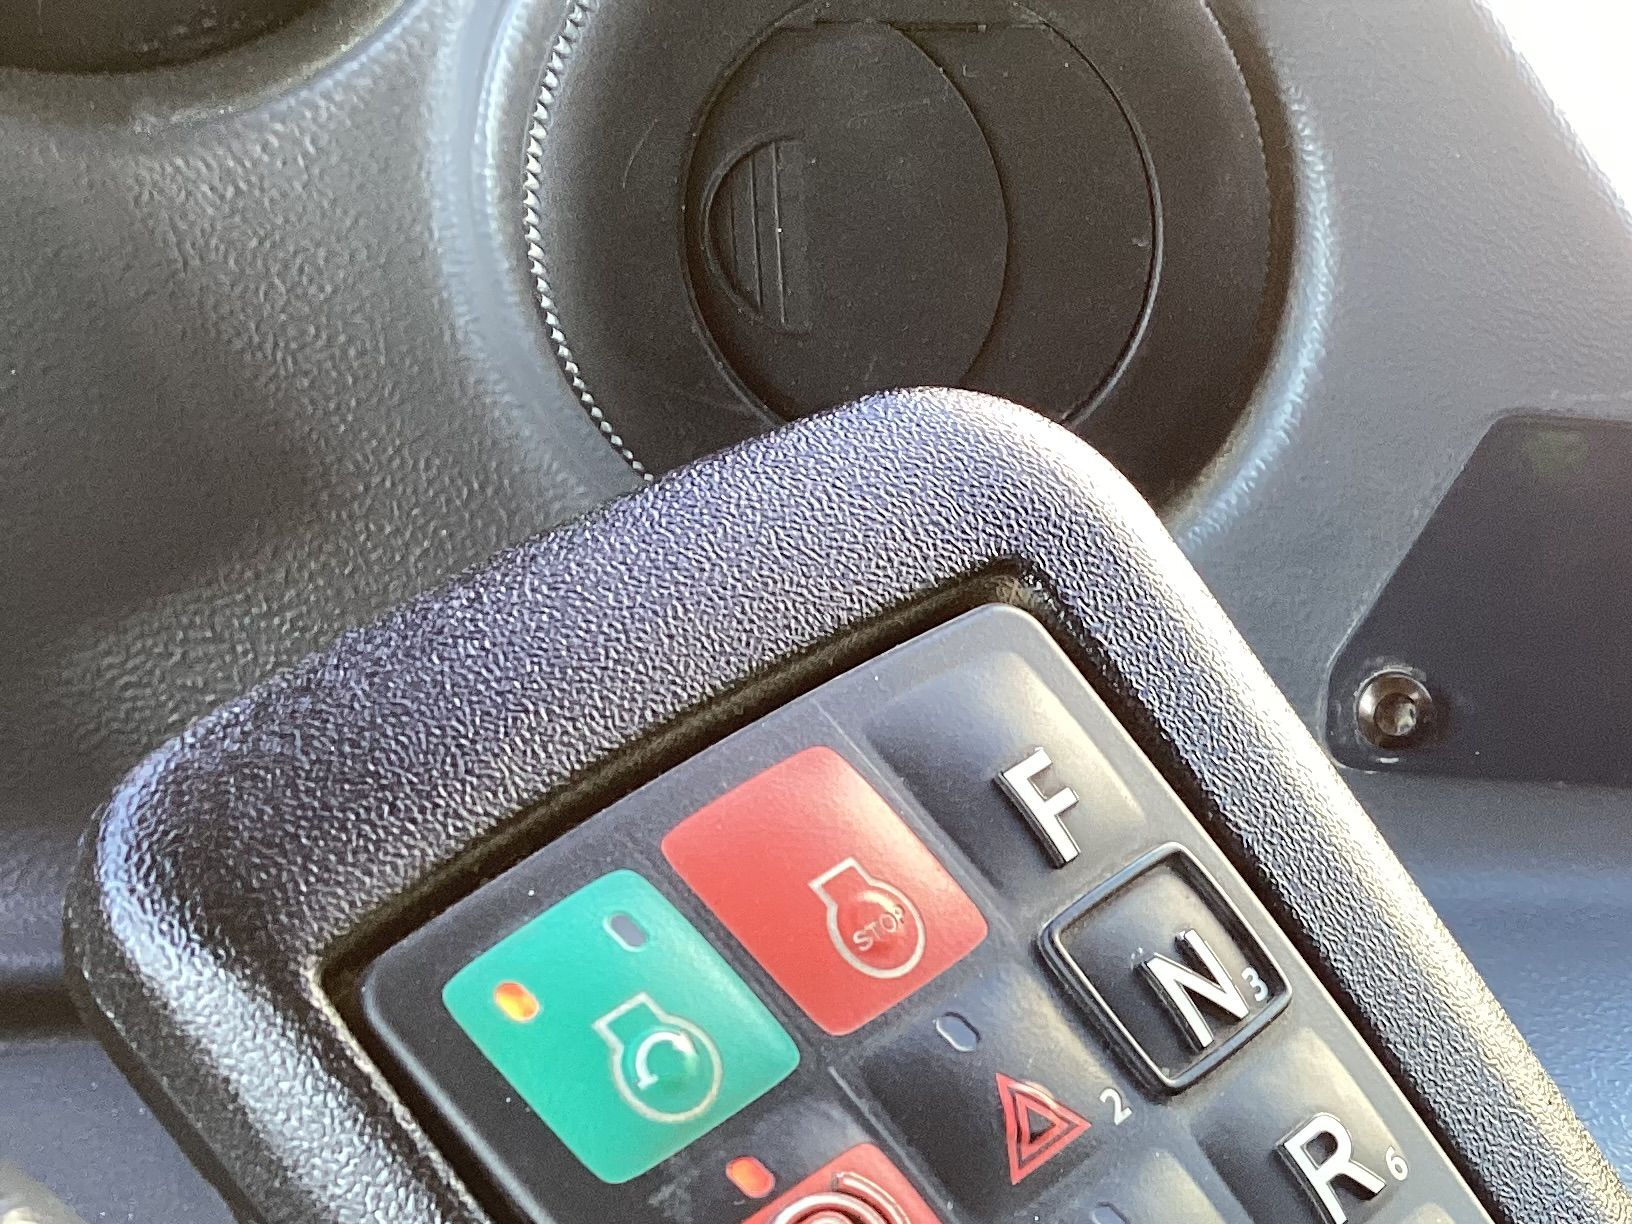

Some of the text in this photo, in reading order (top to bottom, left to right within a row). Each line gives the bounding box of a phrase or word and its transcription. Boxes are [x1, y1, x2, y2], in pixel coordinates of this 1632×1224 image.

[998, 747, 1080, 865] F
[852, 903, 906, 952] STOP
[1144, 929, 1249, 1048] N
[1241, 968, 1269, 1001] 3
[1100, 1087, 1133, 1125] 2
[1386, 1147, 1408, 1181] 6
